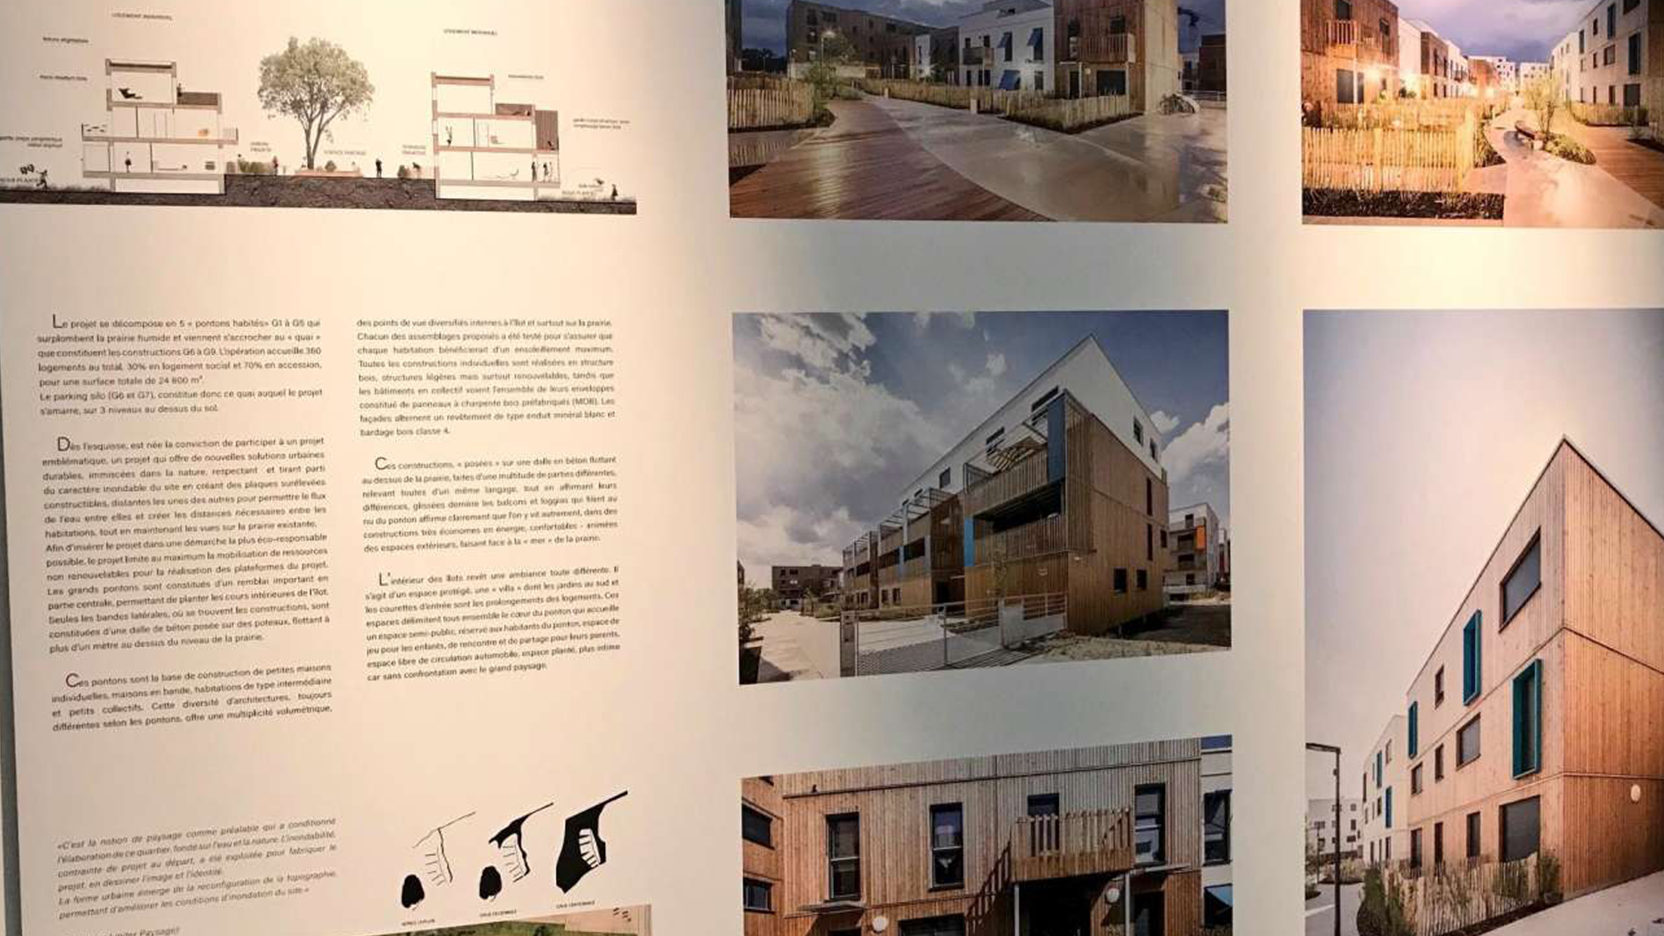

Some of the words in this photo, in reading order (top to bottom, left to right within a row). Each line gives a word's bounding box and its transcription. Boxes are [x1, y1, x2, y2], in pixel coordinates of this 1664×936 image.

[52, 314, 68, 329] Le
[70, 319, 96, 330] projet
[112, 319, 163, 330] décompose
[179, 319, 185, 327] 5
[195, 319, 230, 329] pontons
[271, 318, 282, 327] G1
[284, 318, 290, 327] à
[292, 318, 304, 327] G5
[306, 318, 321, 329] qui
[37, 333, 94, 344] surplombent
[96, 333, 104, 342] la
[107, 333, 135, 344] prairie
[137, 333, 170, 342] humide
[173, 333, 181, 341] et
[184, 333, 221, 341] viennent
[223, 332, 271, 341] s'accrocher
[294, 332, 313, 343] quai
[37, 350, 55, 358] que
[56, 348, 106, 356] constituent
[108, 348, 121, 356] les
[122, 347, 181, 356] constructions
[182, 347, 195, 356] G6
[196, 347, 202, 355] à
[218, 346, 265, 357] L'opération
[266, 346, 304, 355] accueille
[305, 346, 322, 355] 360
[38, 362, 86, 373] logements
[127, 362, 146, 370] 30%
[162, 361, 203, 372] logement
[205, 361, 230, 370] social
[232, 361, 241, 370] et
[244, 361, 262, 370] 70%
[39, 379, 60, 387] pour
[82, 376, 115, 385] surface
[117, 376, 142, 385] totale
[144, 376, 156, 384] de
[158, 376, 169, 384] 24
[39, 391, 51, 400] Le
[53, 391, 87, 402] parking
[90, 391, 105, 399] silo
[126, 390, 135, 399] et
[157, 390, 198, 398] constitue
[200, 389, 221, 398] donc
[236, 388, 255, 399] quai
[257, 388, 286, 399] auquel
[288, 388, 296, 397] le
[298, 388, 323, 398] projet
[99, 406, 105, 414] 3
[108, 405, 142, 414] niveaux
[157, 405, 188, 413] dessus
[190, 404, 202, 413] du
[130, 440, 144, 449] est
[146, 440, 163, 448] née
[165, 440, 173, 448] la
[175, 439, 220, 448] conviction
[222, 438, 233, 447] de
[235, 438, 276, 449] participer
[278, 437, 284, 446] à
[300, 437, 325, 448] projet
[124, 454, 150, 466] projet
[152, 454, 166, 465] qui
[169, 454, 189, 462] offre
[191, 453, 202, 462] de
[204, 452, 245, 462] nouvelles
[247, 452, 286, 460] solutions
[288, 450, 325, 460] urbaines
[49, 644, 69, 654] plus
[71, 642, 90, 651] d'un
[92, 641, 118, 650] mètre
[134, 639, 165, 648] dessus
[167, 637, 178, 646] du
[181, 636, 209, 645] niveau
[211, 635, 222, 644] de
[224, 634, 232, 643] la
[65, 674, 89, 689] Ces
[91, 677, 127, 688] pontons
[130, 674, 149, 684] sont
[151, 674, 159, 683] la
[161, 673, 182, 682] base
[184, 672, 195, 680] de
[197, 668, 251, 680] construction
[252, 667, 264, 676] de
[266, 666, 294, 677] petites
[296, 664, 332, 673] maisons
